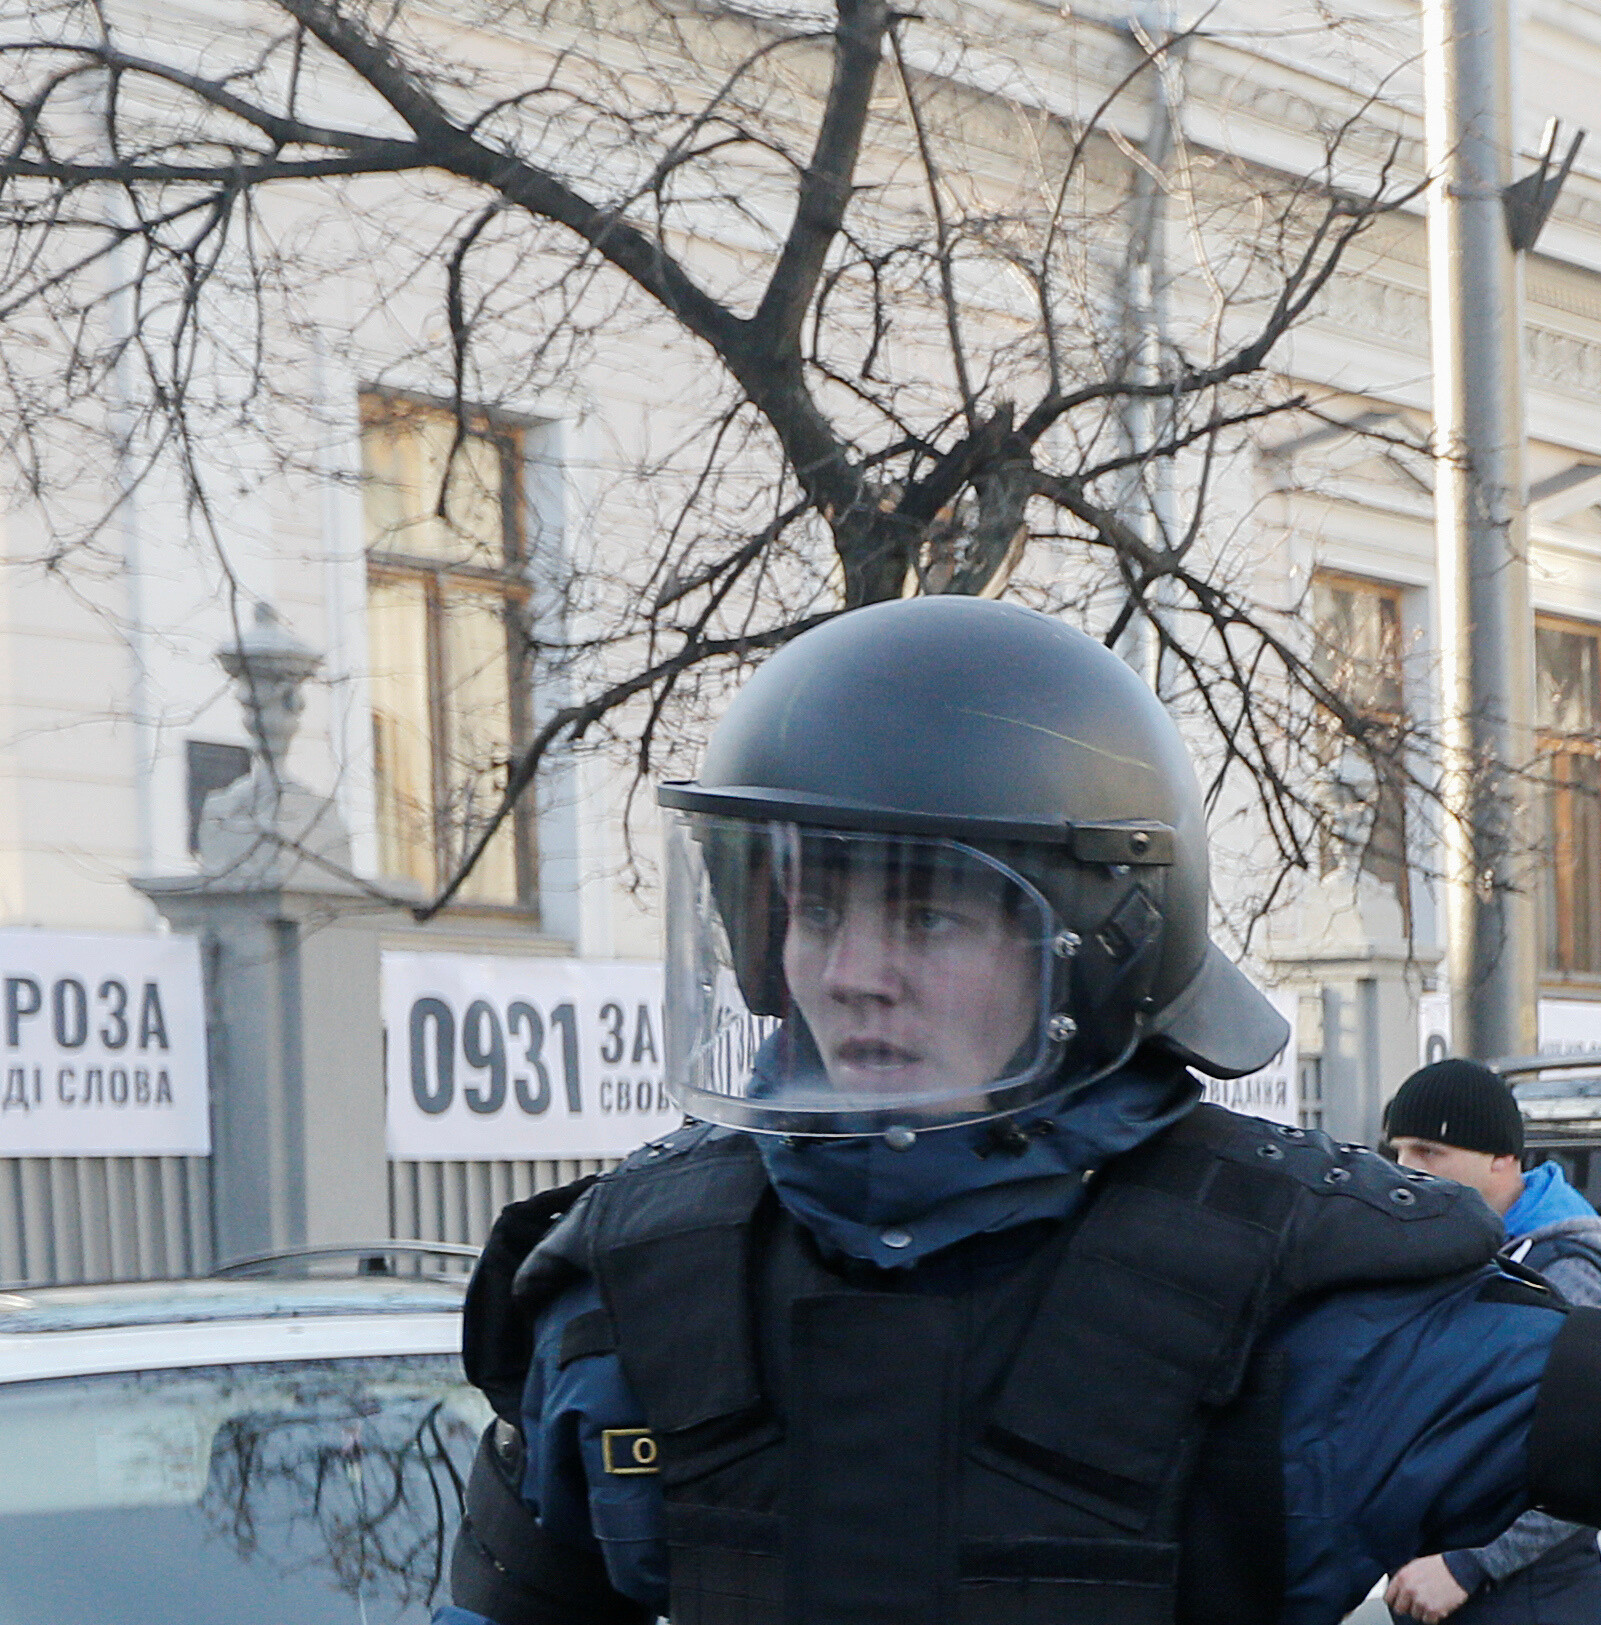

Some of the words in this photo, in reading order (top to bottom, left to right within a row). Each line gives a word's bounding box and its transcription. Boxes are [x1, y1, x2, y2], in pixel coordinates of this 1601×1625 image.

[6, 978, 169, 1049] РОЗА
[600, 1004, 665, 1063] ЗА
[409, 998, 582, 1115] 0931
[3, 1068, 41, 1111] ДІ
[58, 1069, 172, 1103] СЛОВА
